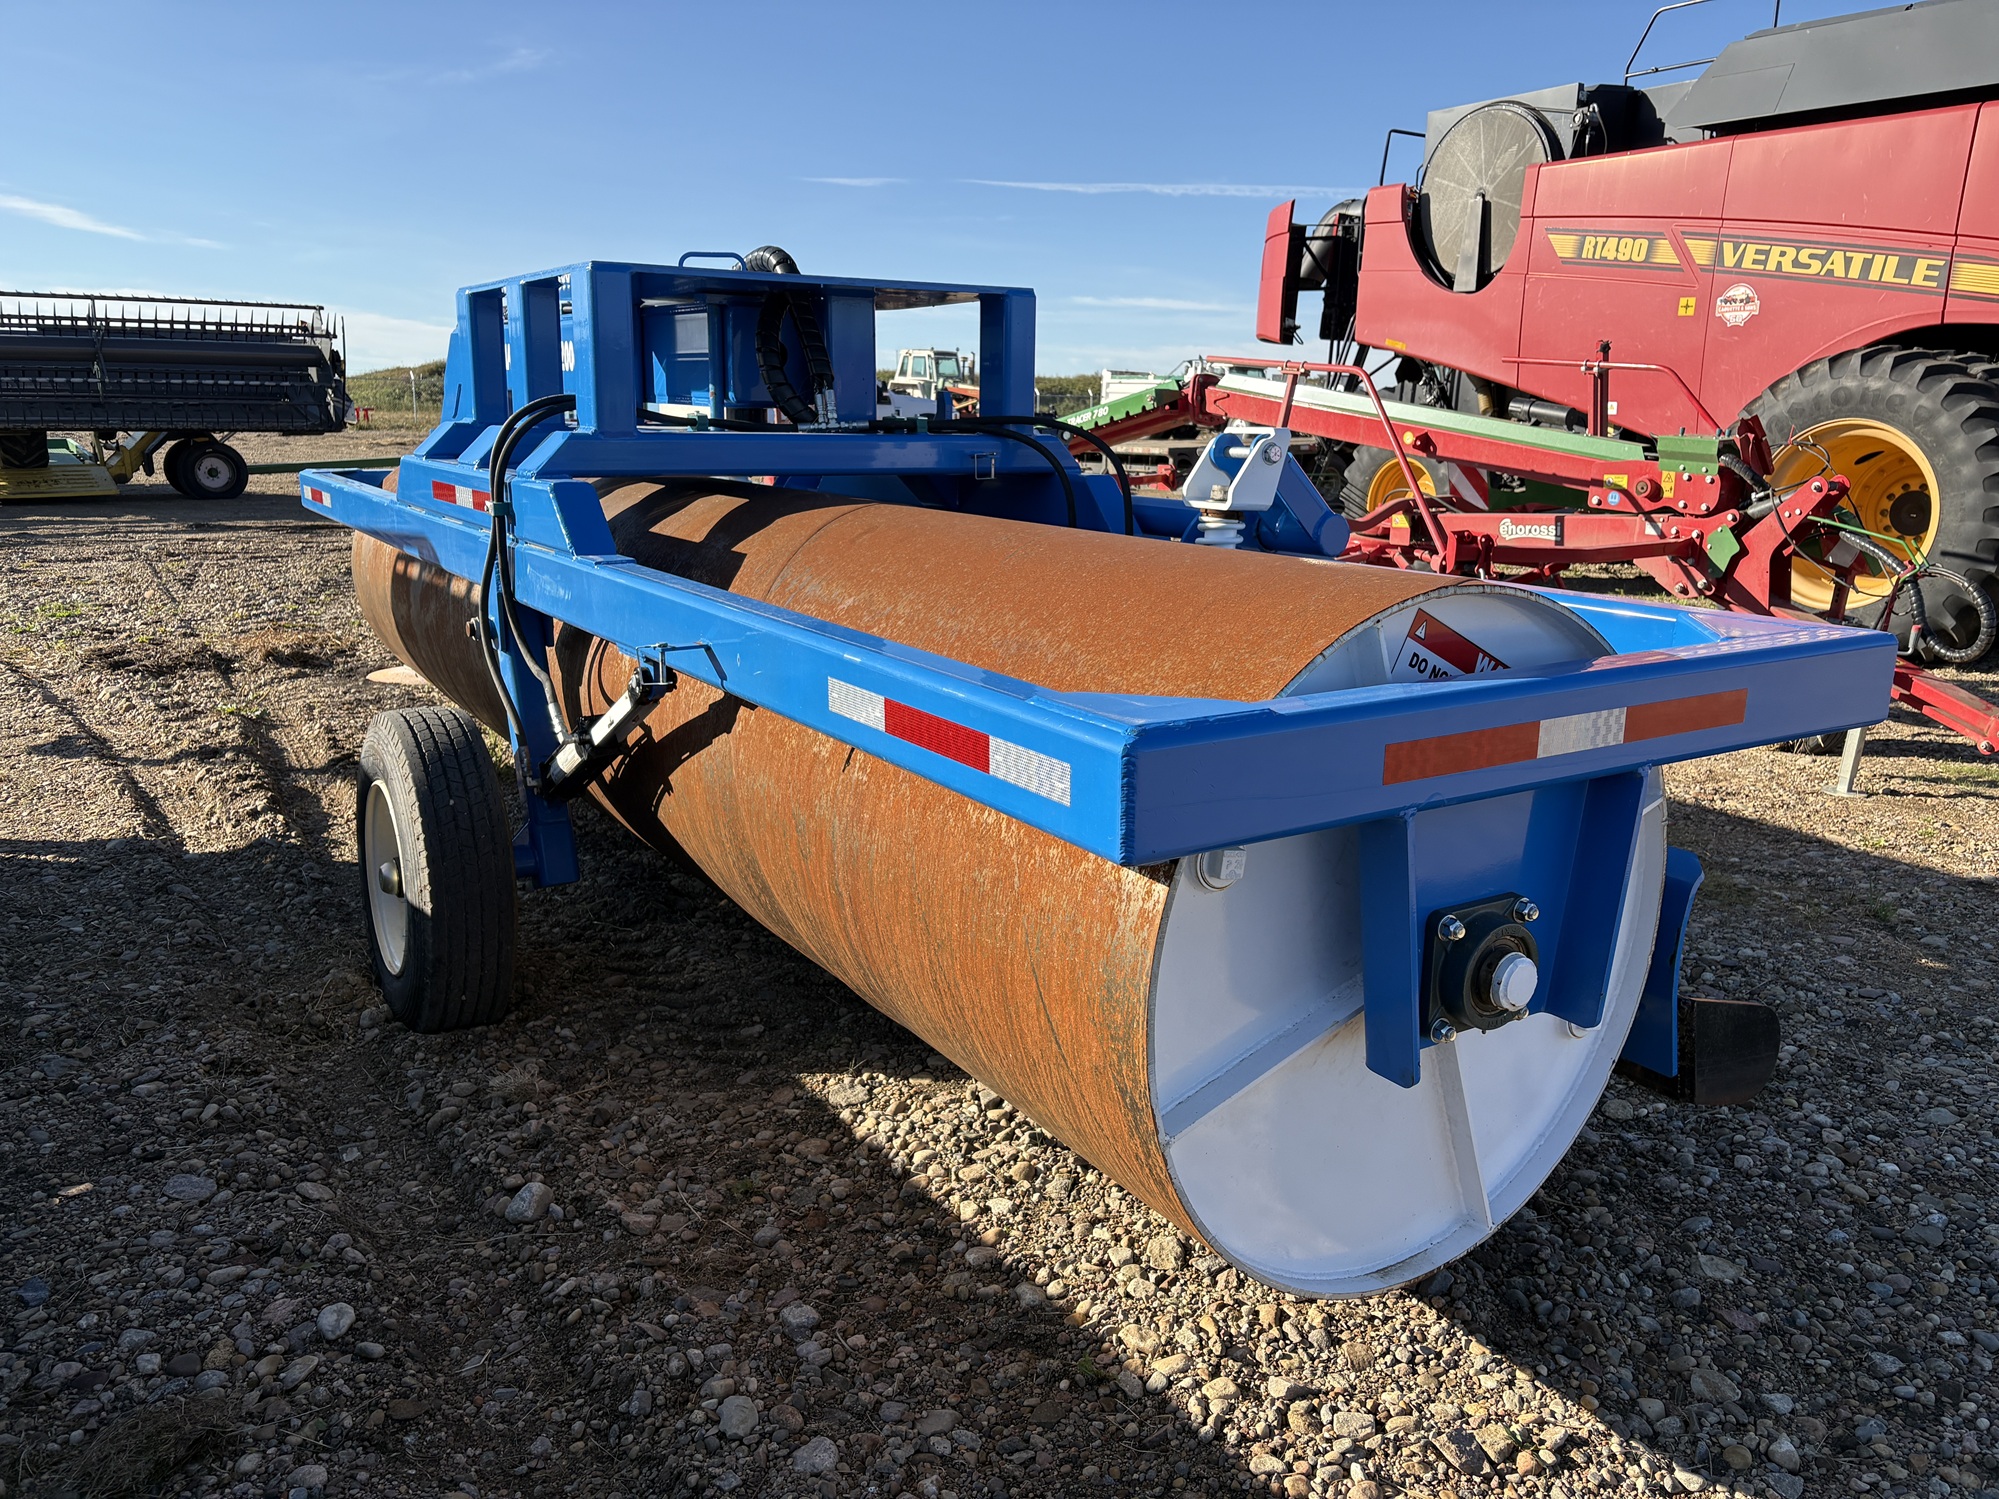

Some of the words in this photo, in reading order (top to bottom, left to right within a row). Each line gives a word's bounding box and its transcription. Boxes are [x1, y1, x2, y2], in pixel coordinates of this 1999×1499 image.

[1581, 235, 1649, 263] RT490
[1722, 241, 1946, 288] VERSATILE
[1066, 411, 1092, 426] TRACER
[1092, 405, 1109, 420] 780
[1408, 651, 1429, 674] DO
